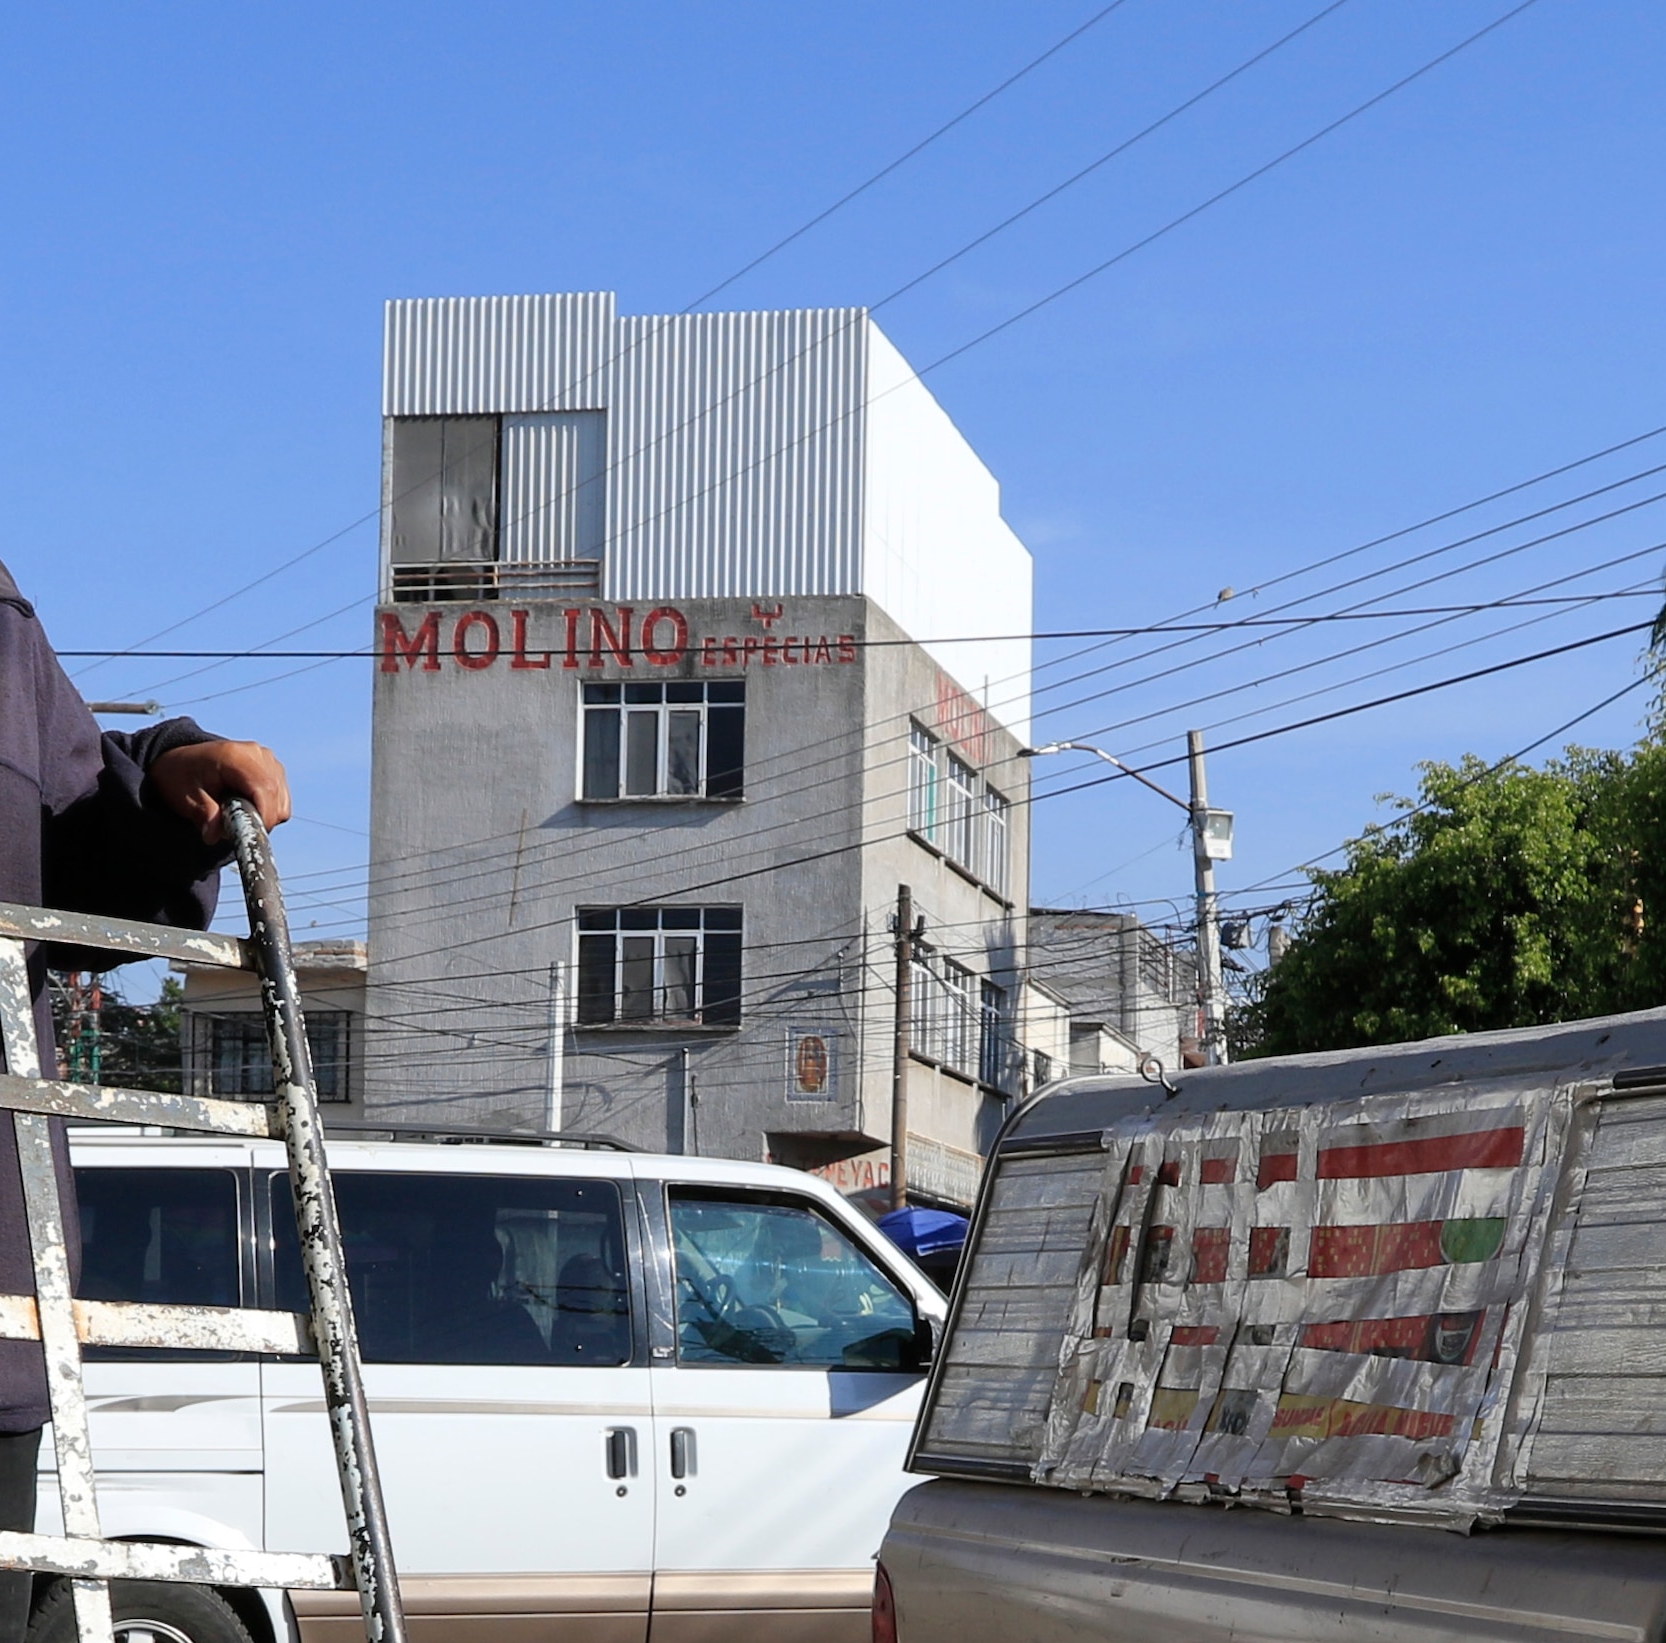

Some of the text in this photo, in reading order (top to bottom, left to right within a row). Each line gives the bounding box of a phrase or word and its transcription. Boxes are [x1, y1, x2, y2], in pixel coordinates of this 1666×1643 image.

[751, 602, 783, 629] Y
[380, 605, 689, 673] MOLINO
[701, 634, 857, 668] ESPECIAS
